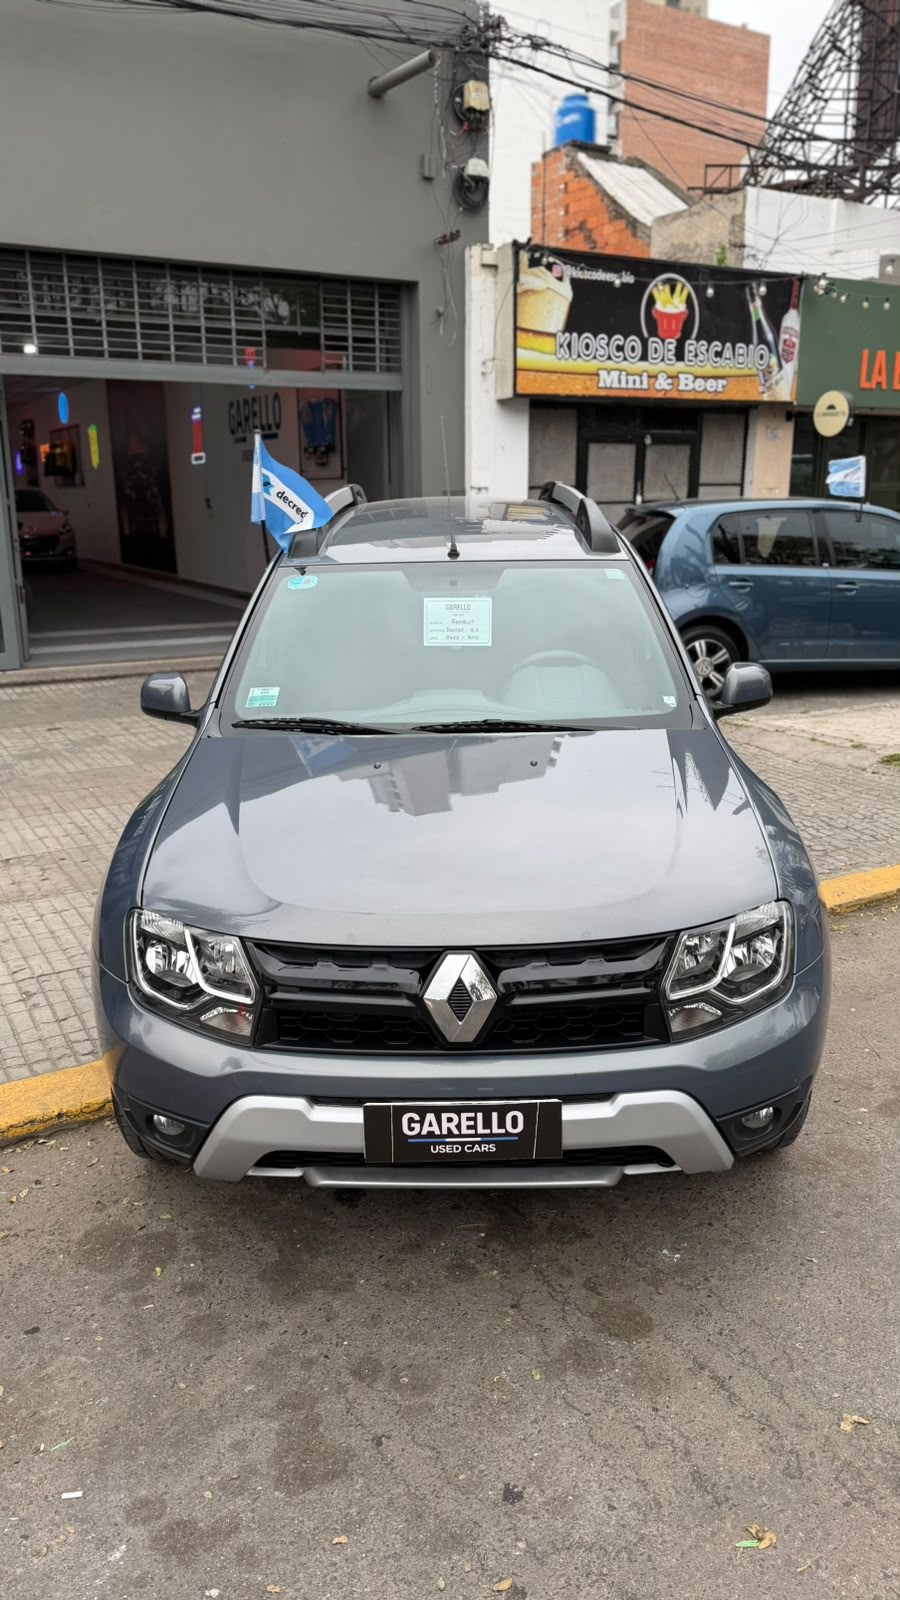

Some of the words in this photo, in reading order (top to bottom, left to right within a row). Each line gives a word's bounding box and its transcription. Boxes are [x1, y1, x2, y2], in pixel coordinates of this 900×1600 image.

[556, 332, 643, 362] KIOSCO
[648, 338, 677, 364] DE
[684, 340, 770, 369] ESCABIO
[597, 369, 649, 389] Mini
[654, 372, 673, 391] &
[678, 372, 728, 392] Beer
[859, 349, 888, 390] LA
[228, 392, 282, 435] GARELLO
[445, 603, 472, 611] GARELLO
[401, 1111, 524, 1136] GARELLO
[430, 1144, 462, 1153] USED
[464, 1144, 497, 1153] CARS
